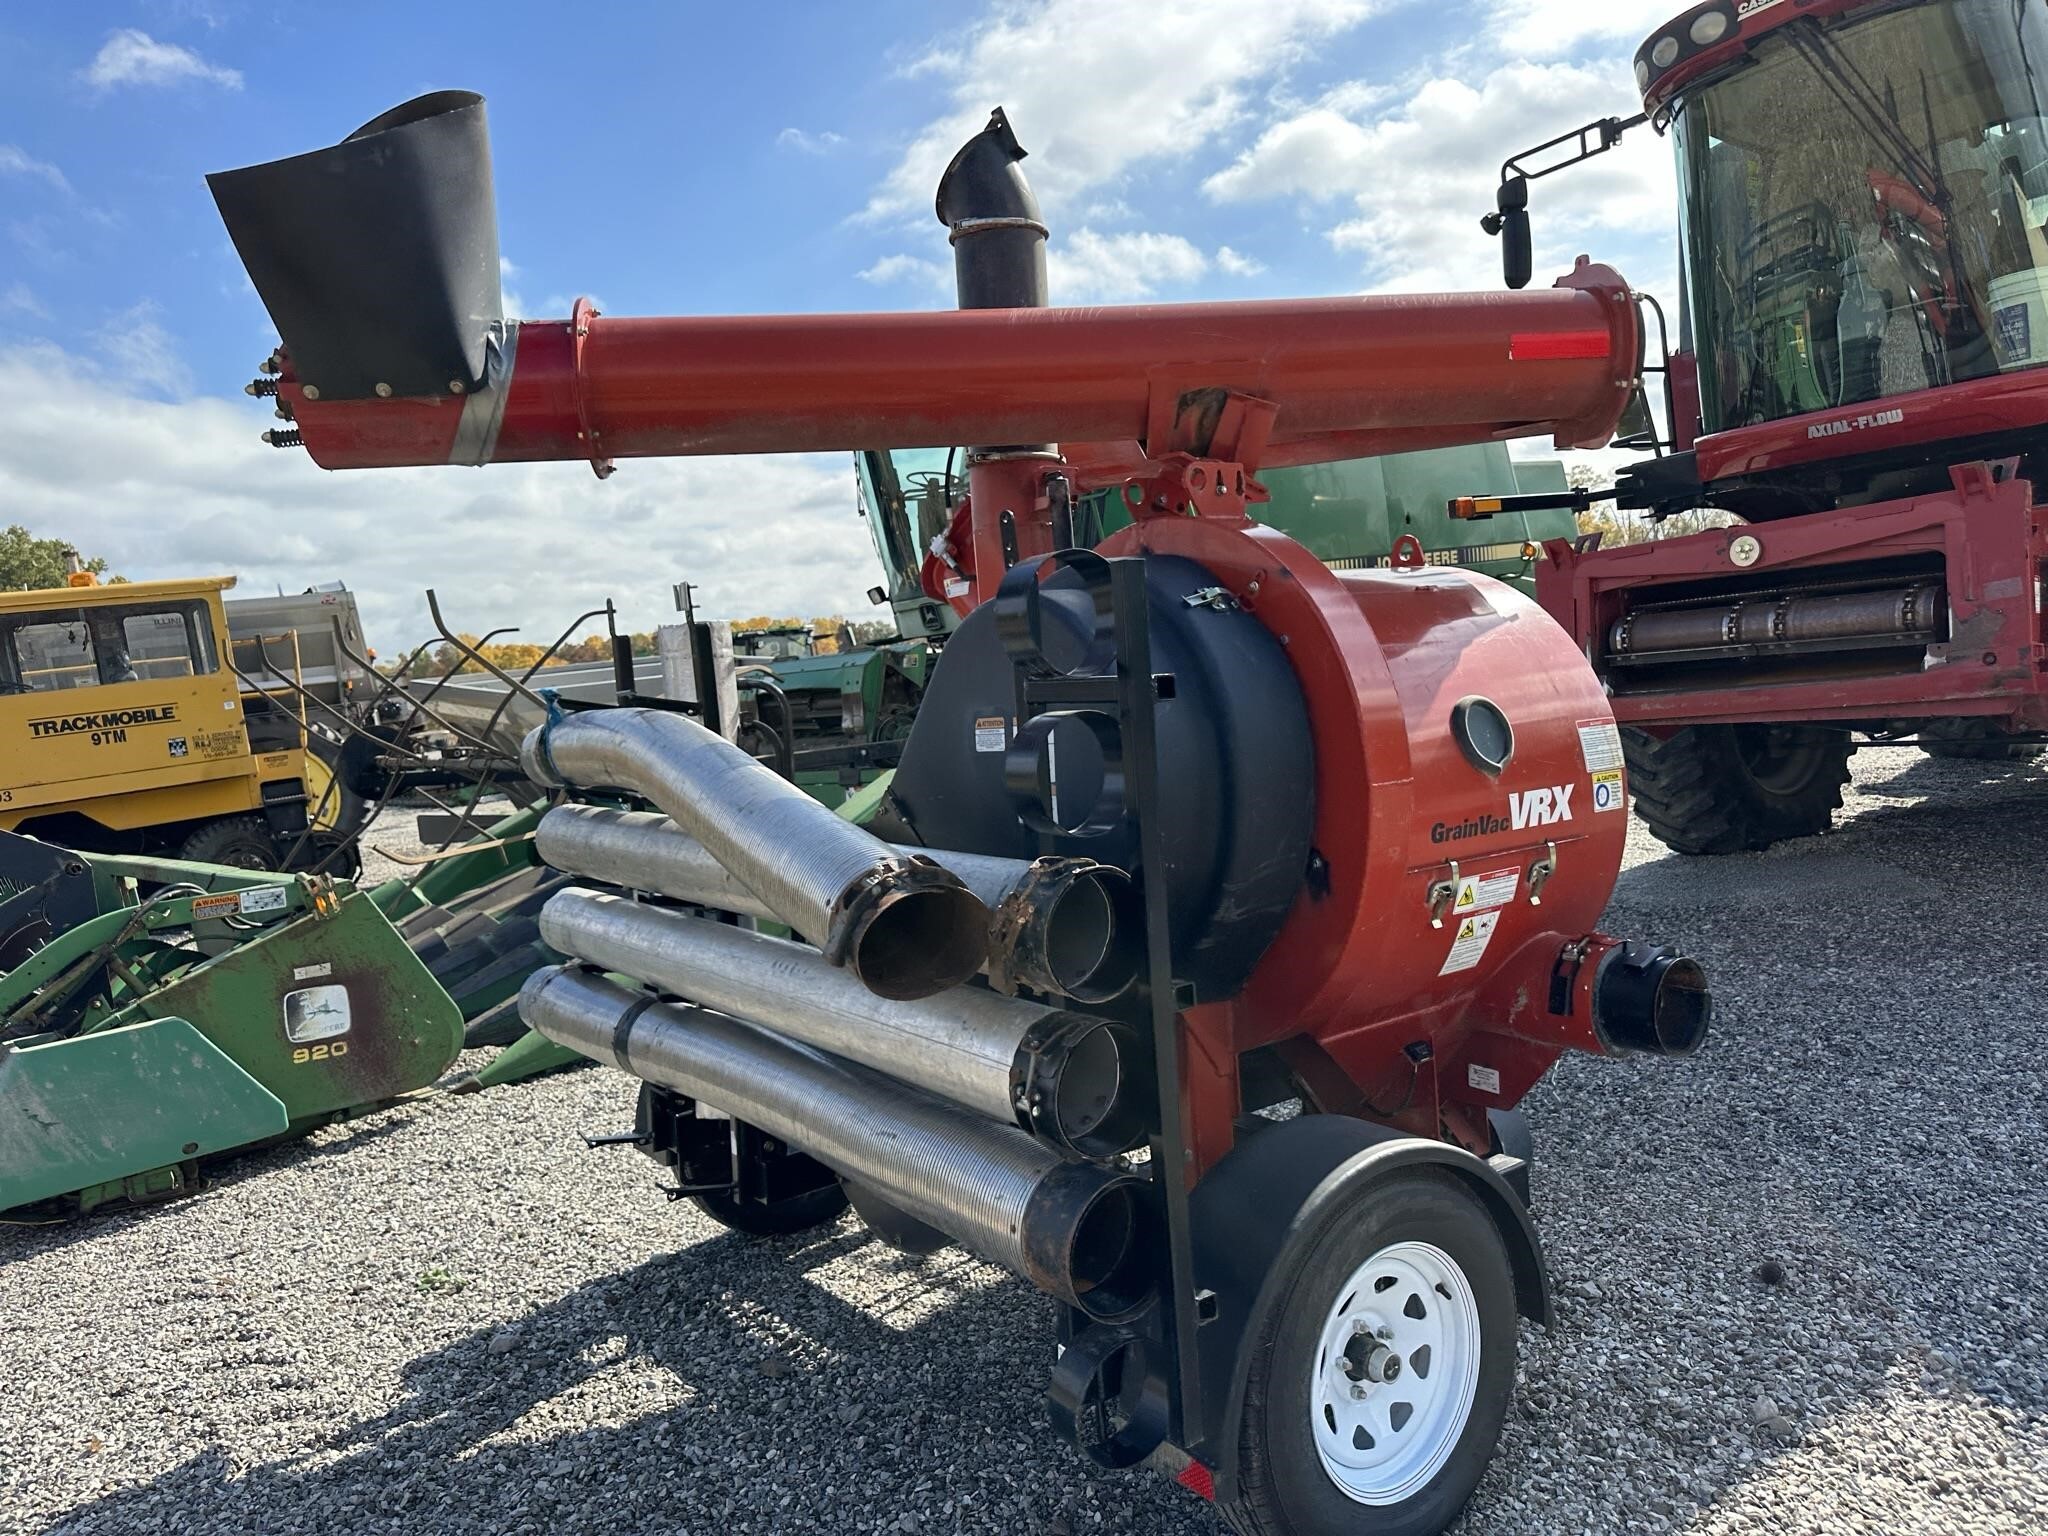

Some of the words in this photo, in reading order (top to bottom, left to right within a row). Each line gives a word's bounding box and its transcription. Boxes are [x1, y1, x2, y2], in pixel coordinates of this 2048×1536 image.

[1807, 408, 1904, 439] AXIAL-FLOW
[1424, 549, 1458, 566] EERE
[28, 706, 176, 736] TRACKMOBILE
[91, 729, 127, 746] 9TM
[1431, 815, 1509, 844] GrainVac
[1508, 783, 1575, 831] VRX
[202, 895, 238, 907] WARNING
[293, 1041, 348, 1064] 920
